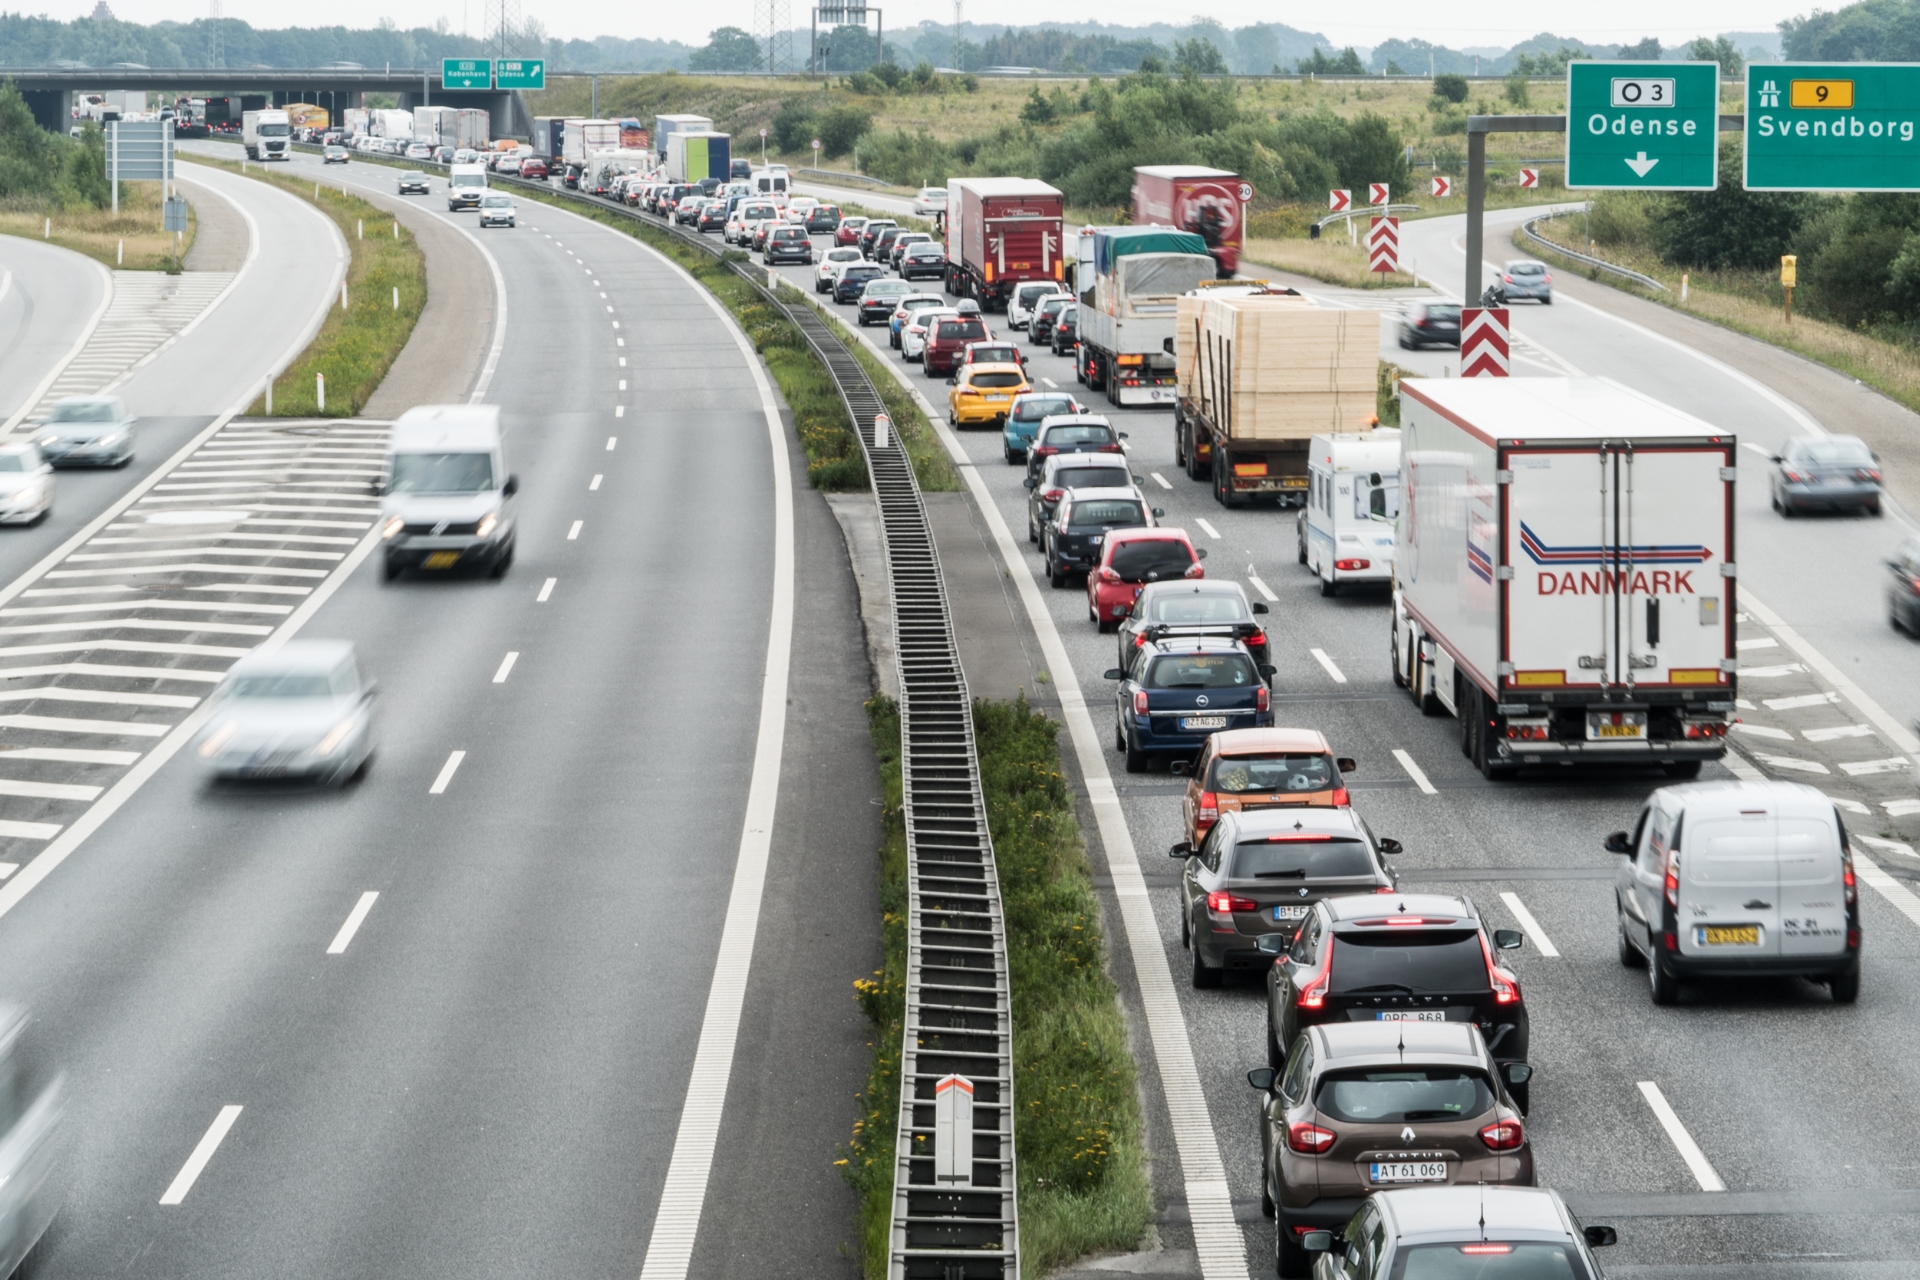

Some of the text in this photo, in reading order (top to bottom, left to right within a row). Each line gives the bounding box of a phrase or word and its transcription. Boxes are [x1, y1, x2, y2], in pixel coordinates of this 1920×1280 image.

[1650, 84, 1663, 101] 3
[1815, 85, 1829, 102] 9
[1588, 114, 1697, 136] Odense
[1757, 115, 1914, 141] Svendborg
[1237, 187, 1251, 196] 90
[1537, 570, 1695, 596] DANMARK
[1200, 717, 1210, 726] AG
[1211, 717, 1226, 726] 235
[1280, 907, 1287, 917] B
[1375, 1151, 1443, 1160] CAPTUR
[1380, 1163, 1445, 1177] AT 61 069
